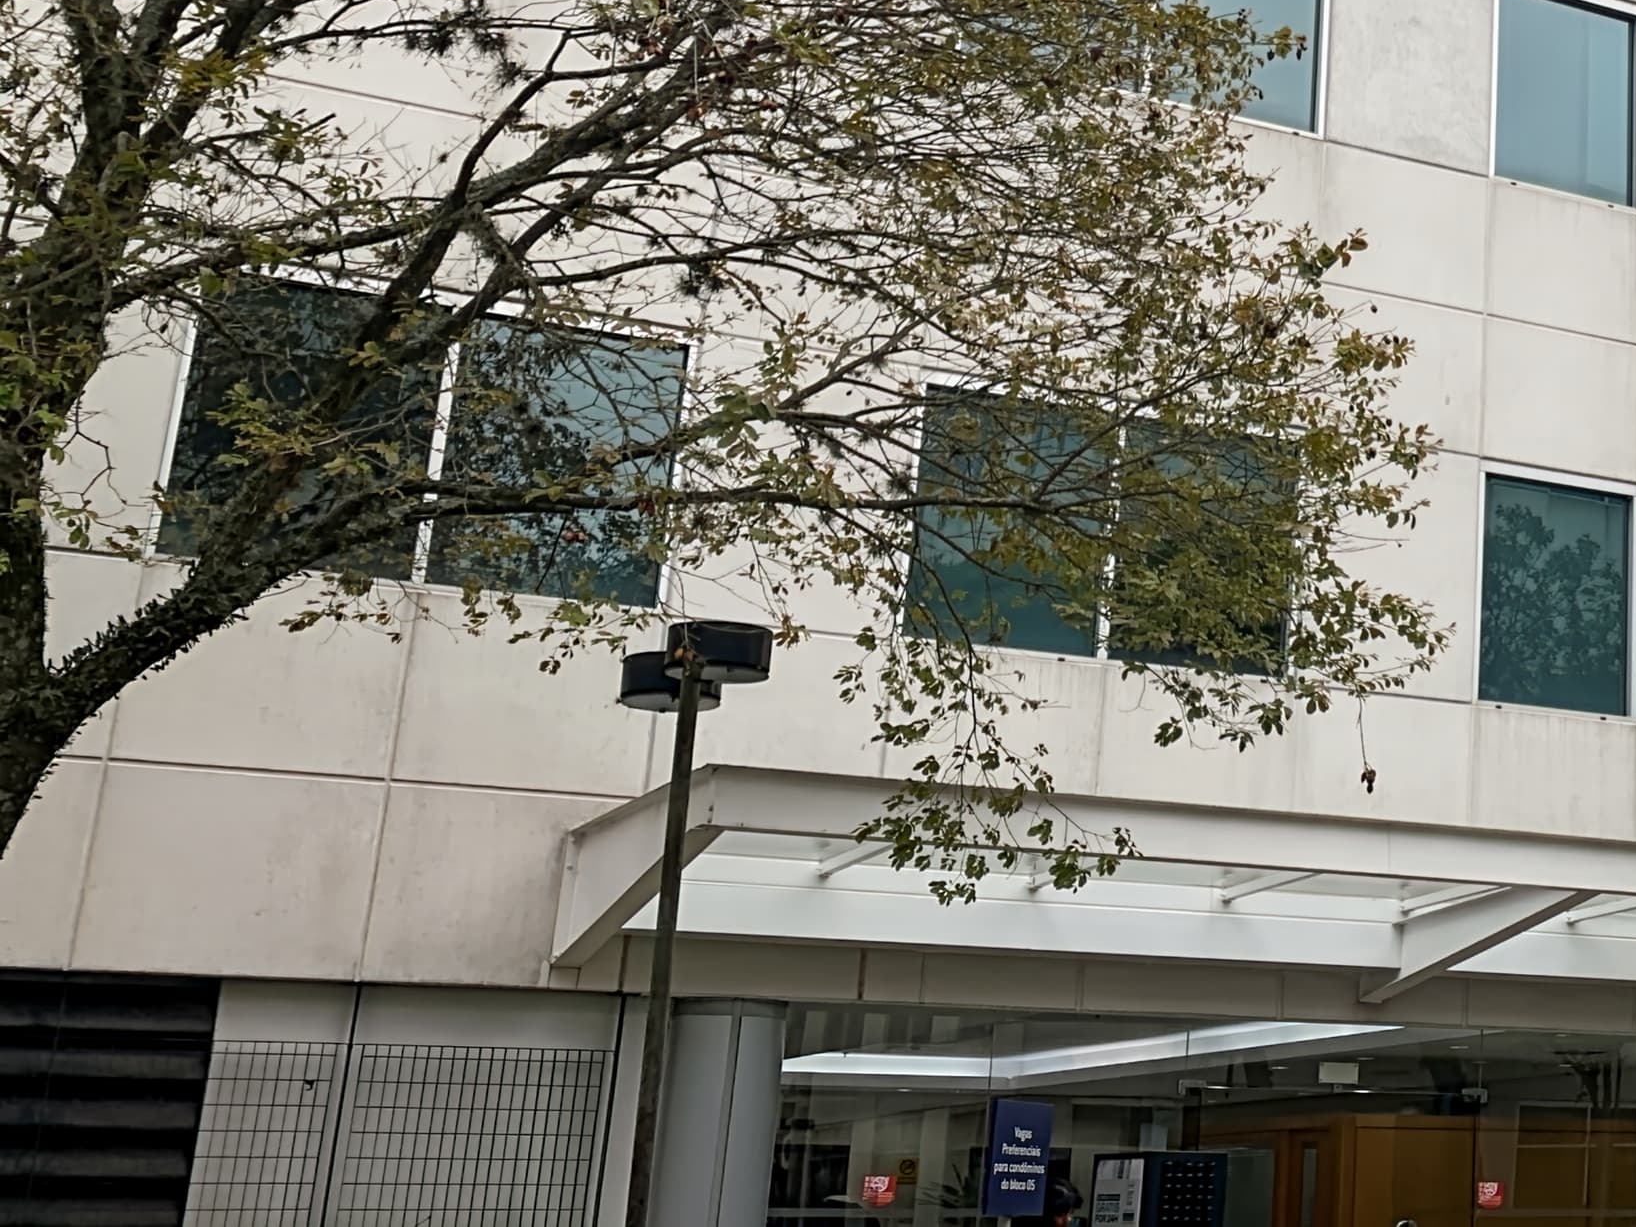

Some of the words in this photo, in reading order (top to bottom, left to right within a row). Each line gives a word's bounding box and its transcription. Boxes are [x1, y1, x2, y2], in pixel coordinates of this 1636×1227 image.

[1014, 1126, 1033, 1142] Vagas
[1001, 1142, 1041, 1157] Preferenciais
[993, 1163, 1008, 1175] para
[1001, 1178, 1009, 1190] do
[1009, 1179, 1026, 1190] bloco
[1026, 1179, 1036, 1190] 05
